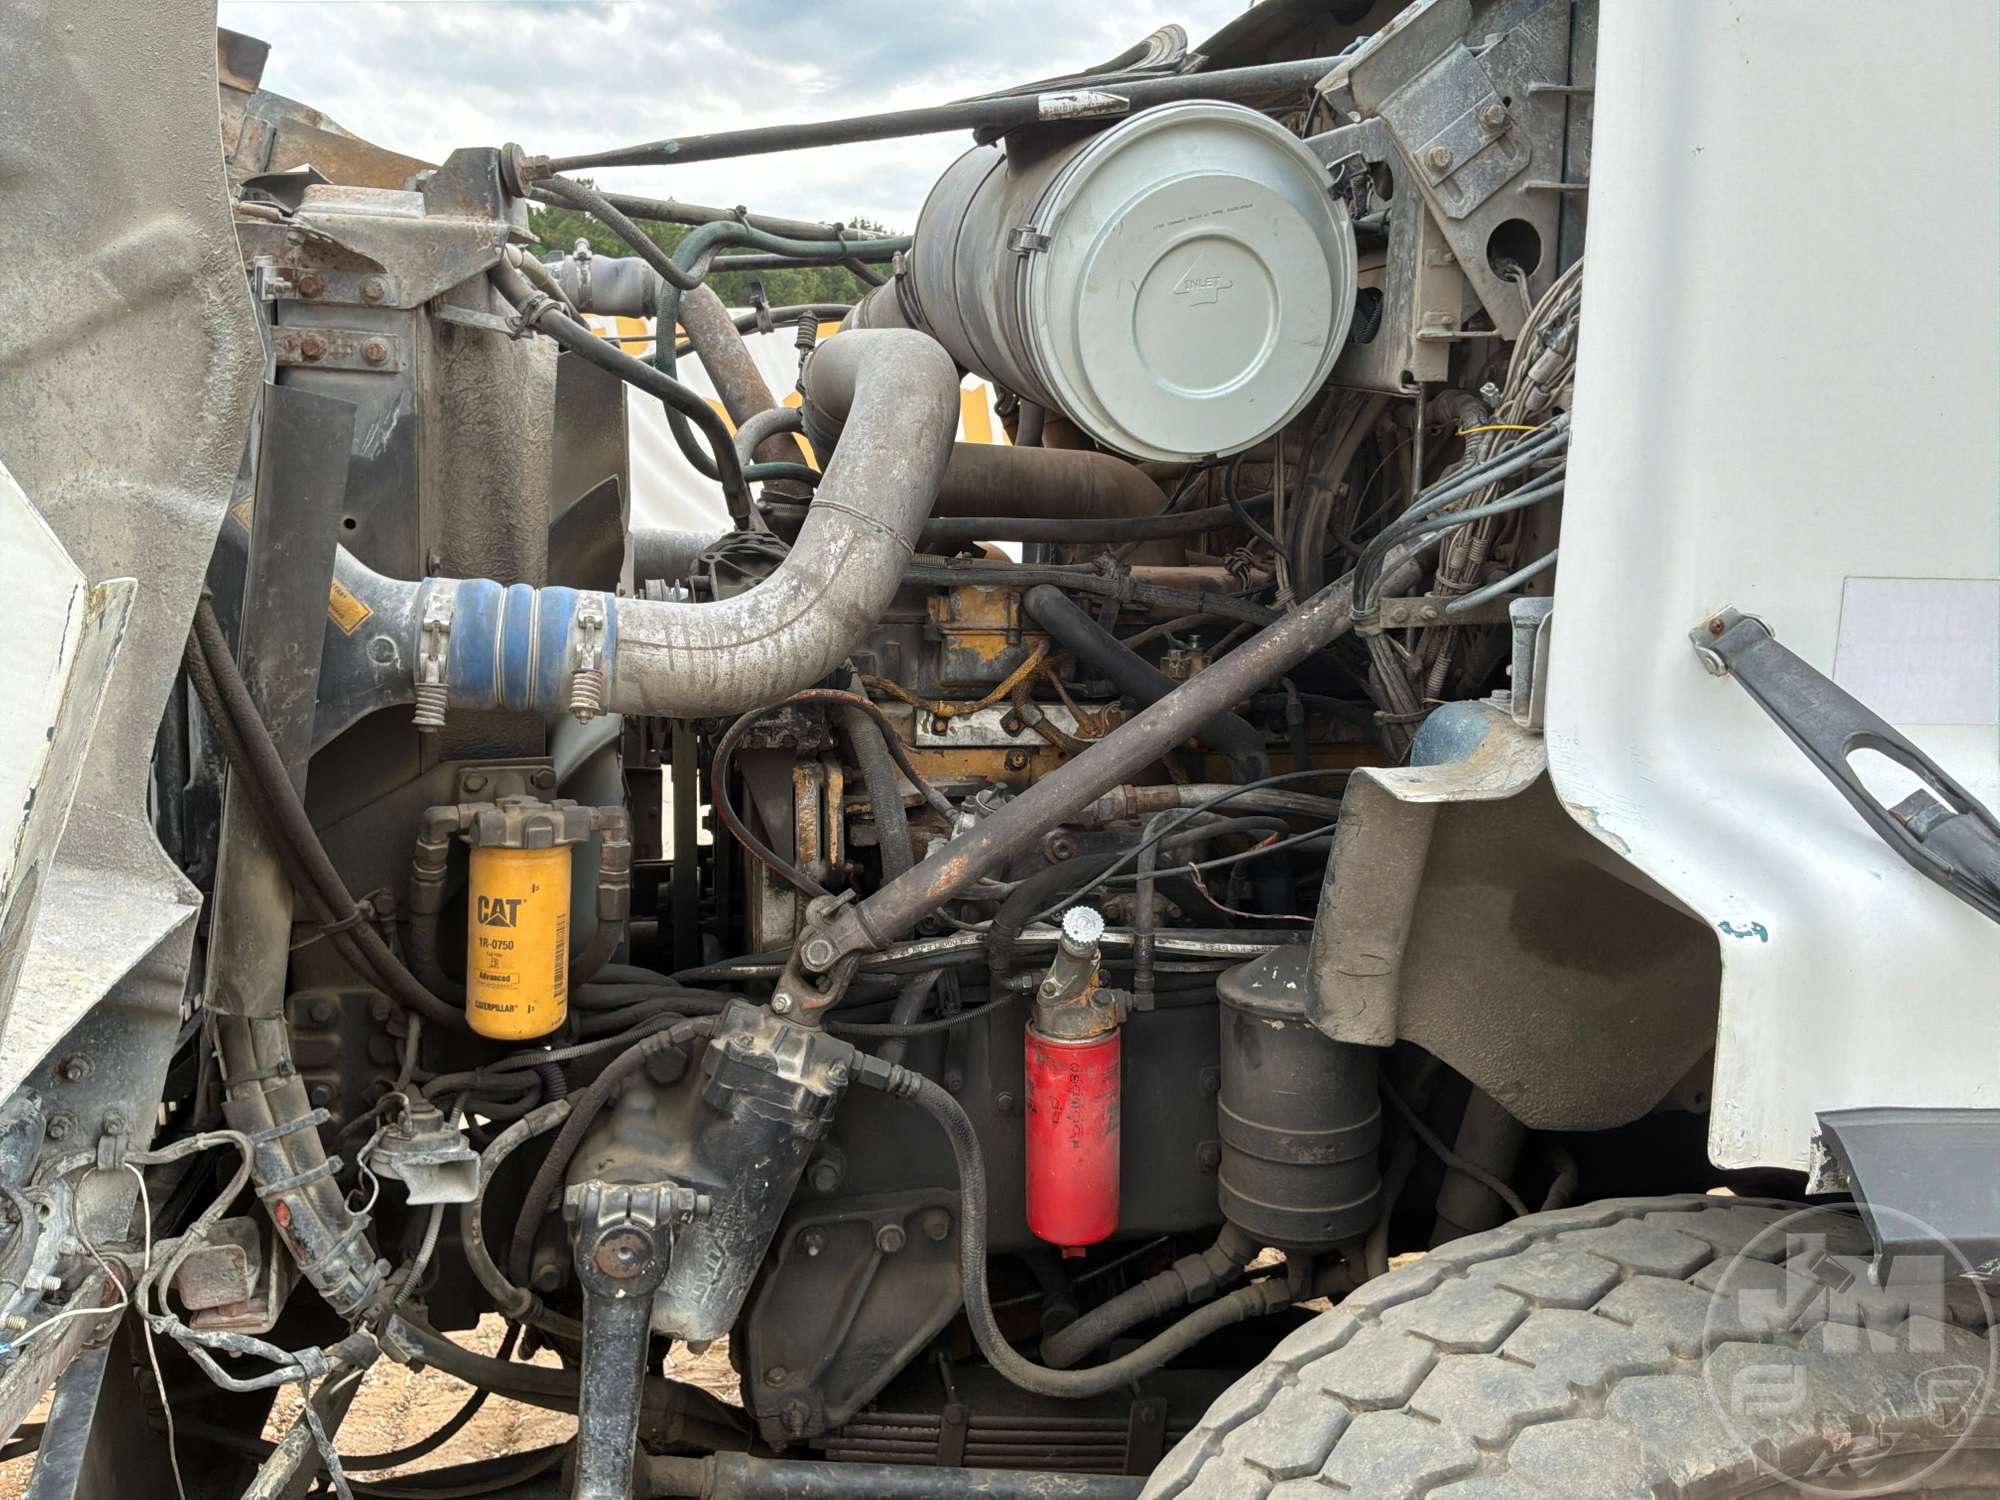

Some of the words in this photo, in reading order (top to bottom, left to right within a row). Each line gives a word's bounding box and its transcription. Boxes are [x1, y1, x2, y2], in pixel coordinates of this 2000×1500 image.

[1184, 276, 1221, 291] INLET
[477, 895, 522, 928] CAT
[479, 937, 515, 951] 1R-0750
